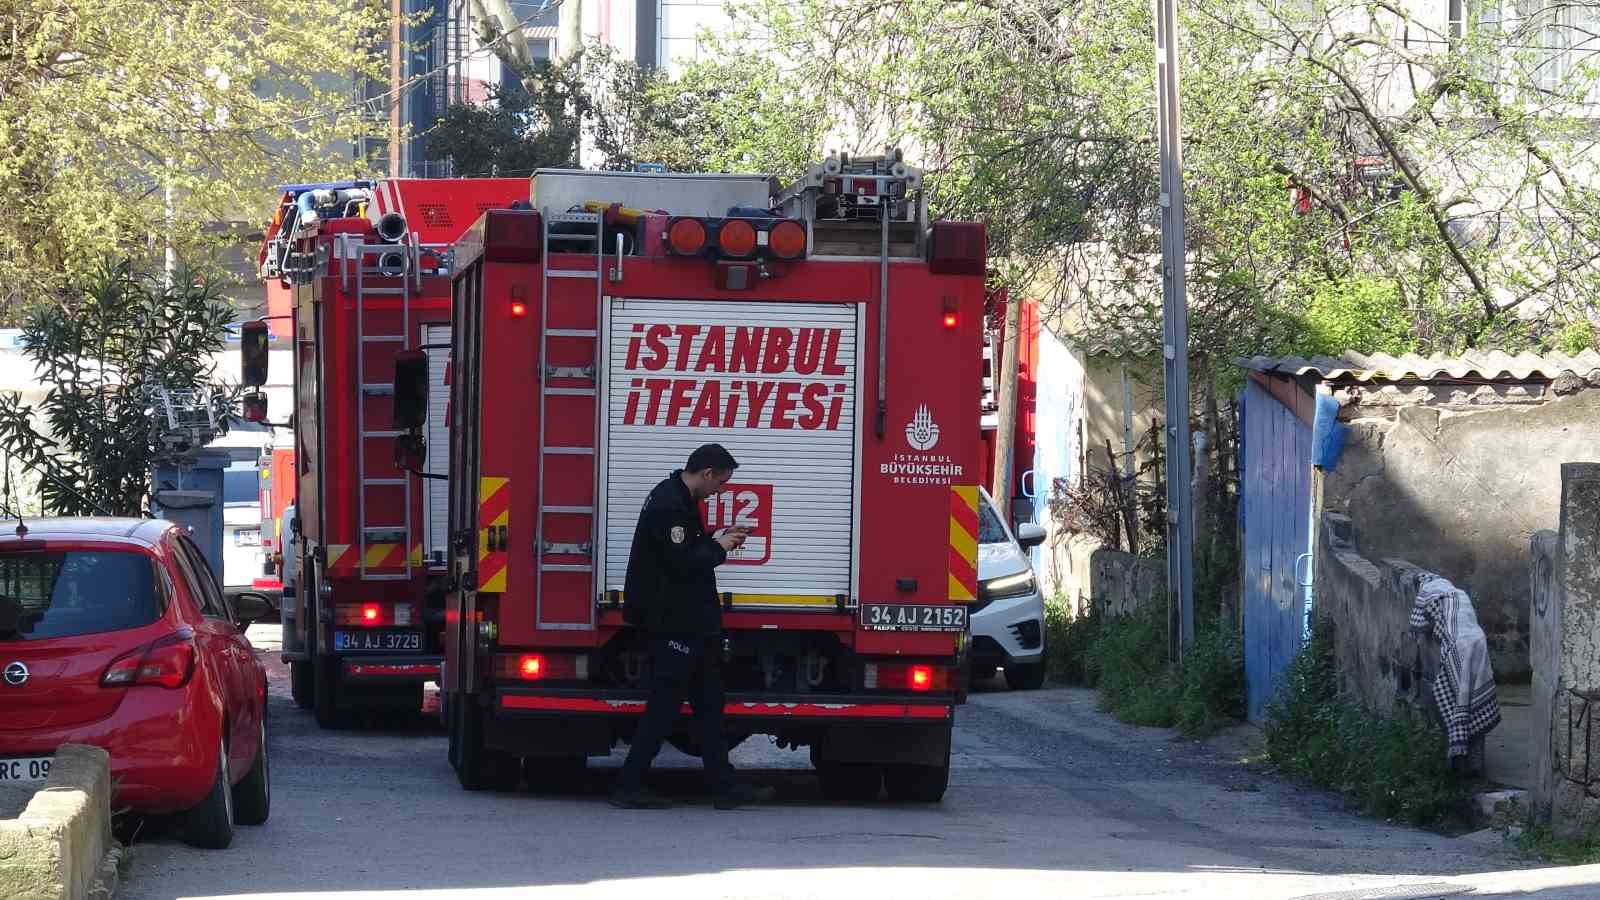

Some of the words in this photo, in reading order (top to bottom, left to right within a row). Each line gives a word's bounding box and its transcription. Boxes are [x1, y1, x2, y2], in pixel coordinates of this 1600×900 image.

[704, 490, 760, 528] 112
[871, 606, 892, 624] 34
[897, 607, 917, 625] AJ
[923, 607, 963, 626] 2152
[343, 634, 360, 649] 34
[364, 634, 380, 649] AJ
[386, 634, 420, 649] 3729
